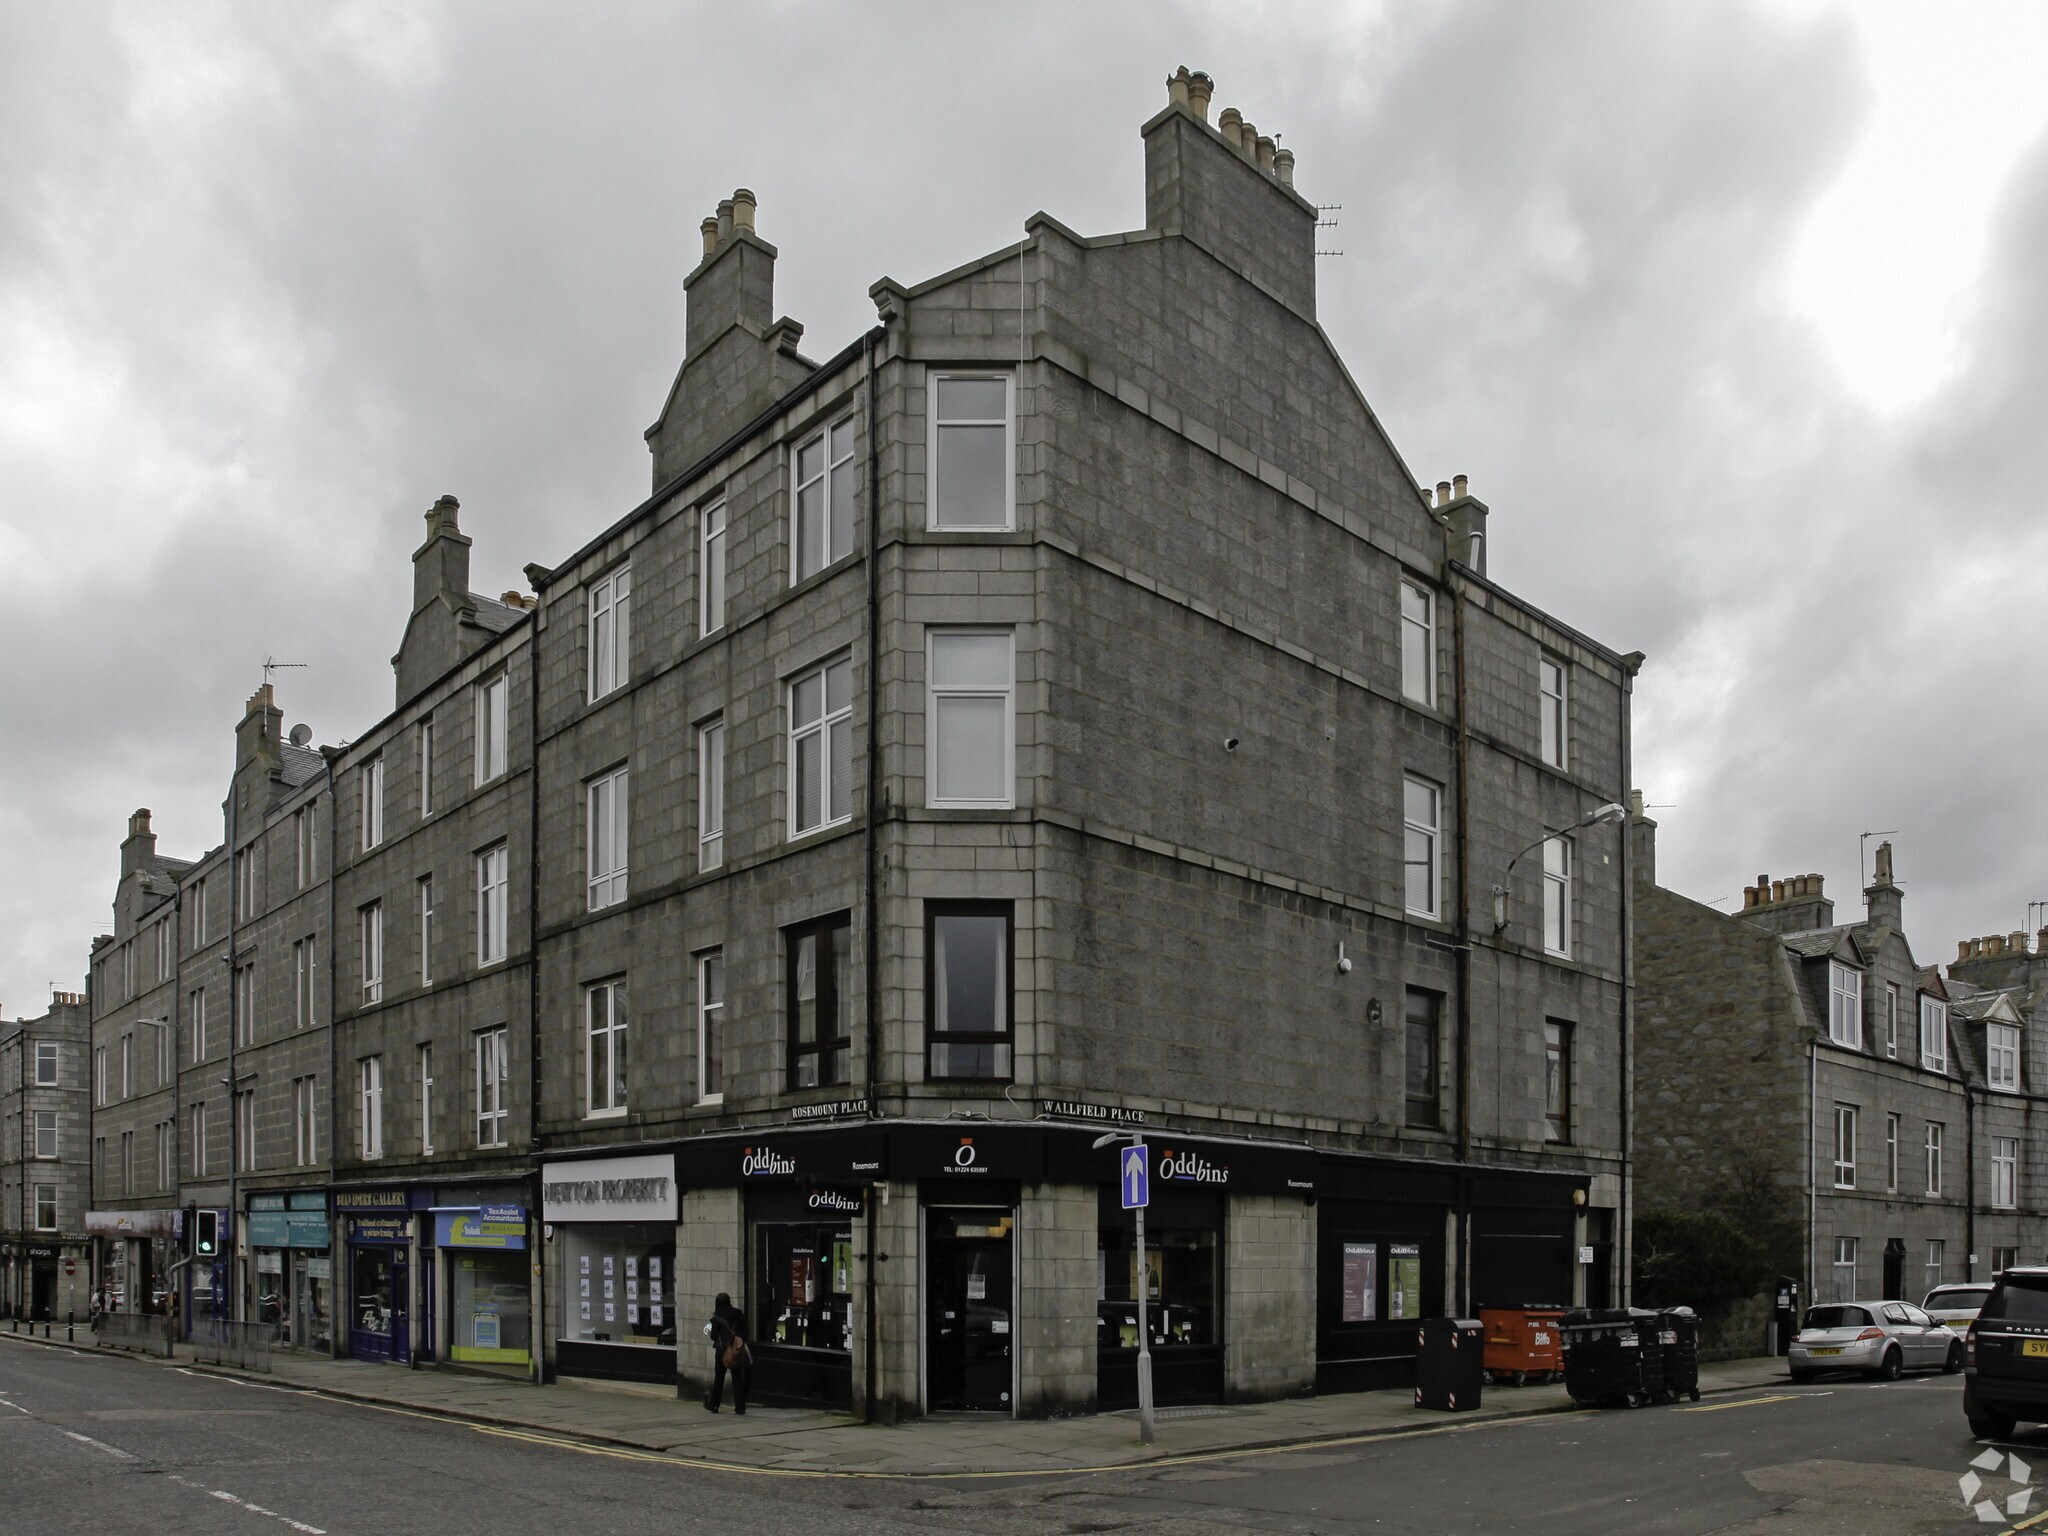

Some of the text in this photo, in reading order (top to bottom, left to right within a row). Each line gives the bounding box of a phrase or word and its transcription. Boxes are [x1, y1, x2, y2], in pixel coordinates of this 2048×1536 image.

[792, 1103, 839, 1119] ROSEMOUNT
[1043, 1100, 1145, 1122] WALLFIELD PLACE
[743, 1147, 796, 1176] Oddbins
[852, 1161, 879, 1171] Rosemount
[1159, 1152, 1229, 1183] Oddbins
[544, 1177, 668, 1203] NEWTON PROPERTY
[1288, 1179, 1313, 1188] Rosemount
[373, 1191, 406, 1206] GALLERY
[809, 1191, 860, 1210] Oddbins
[482, 1214, 525, 1223] Accountants
[487, 1207, 520, 1216] TaxAssist
[30, 1248, 51, 1256] sharps
